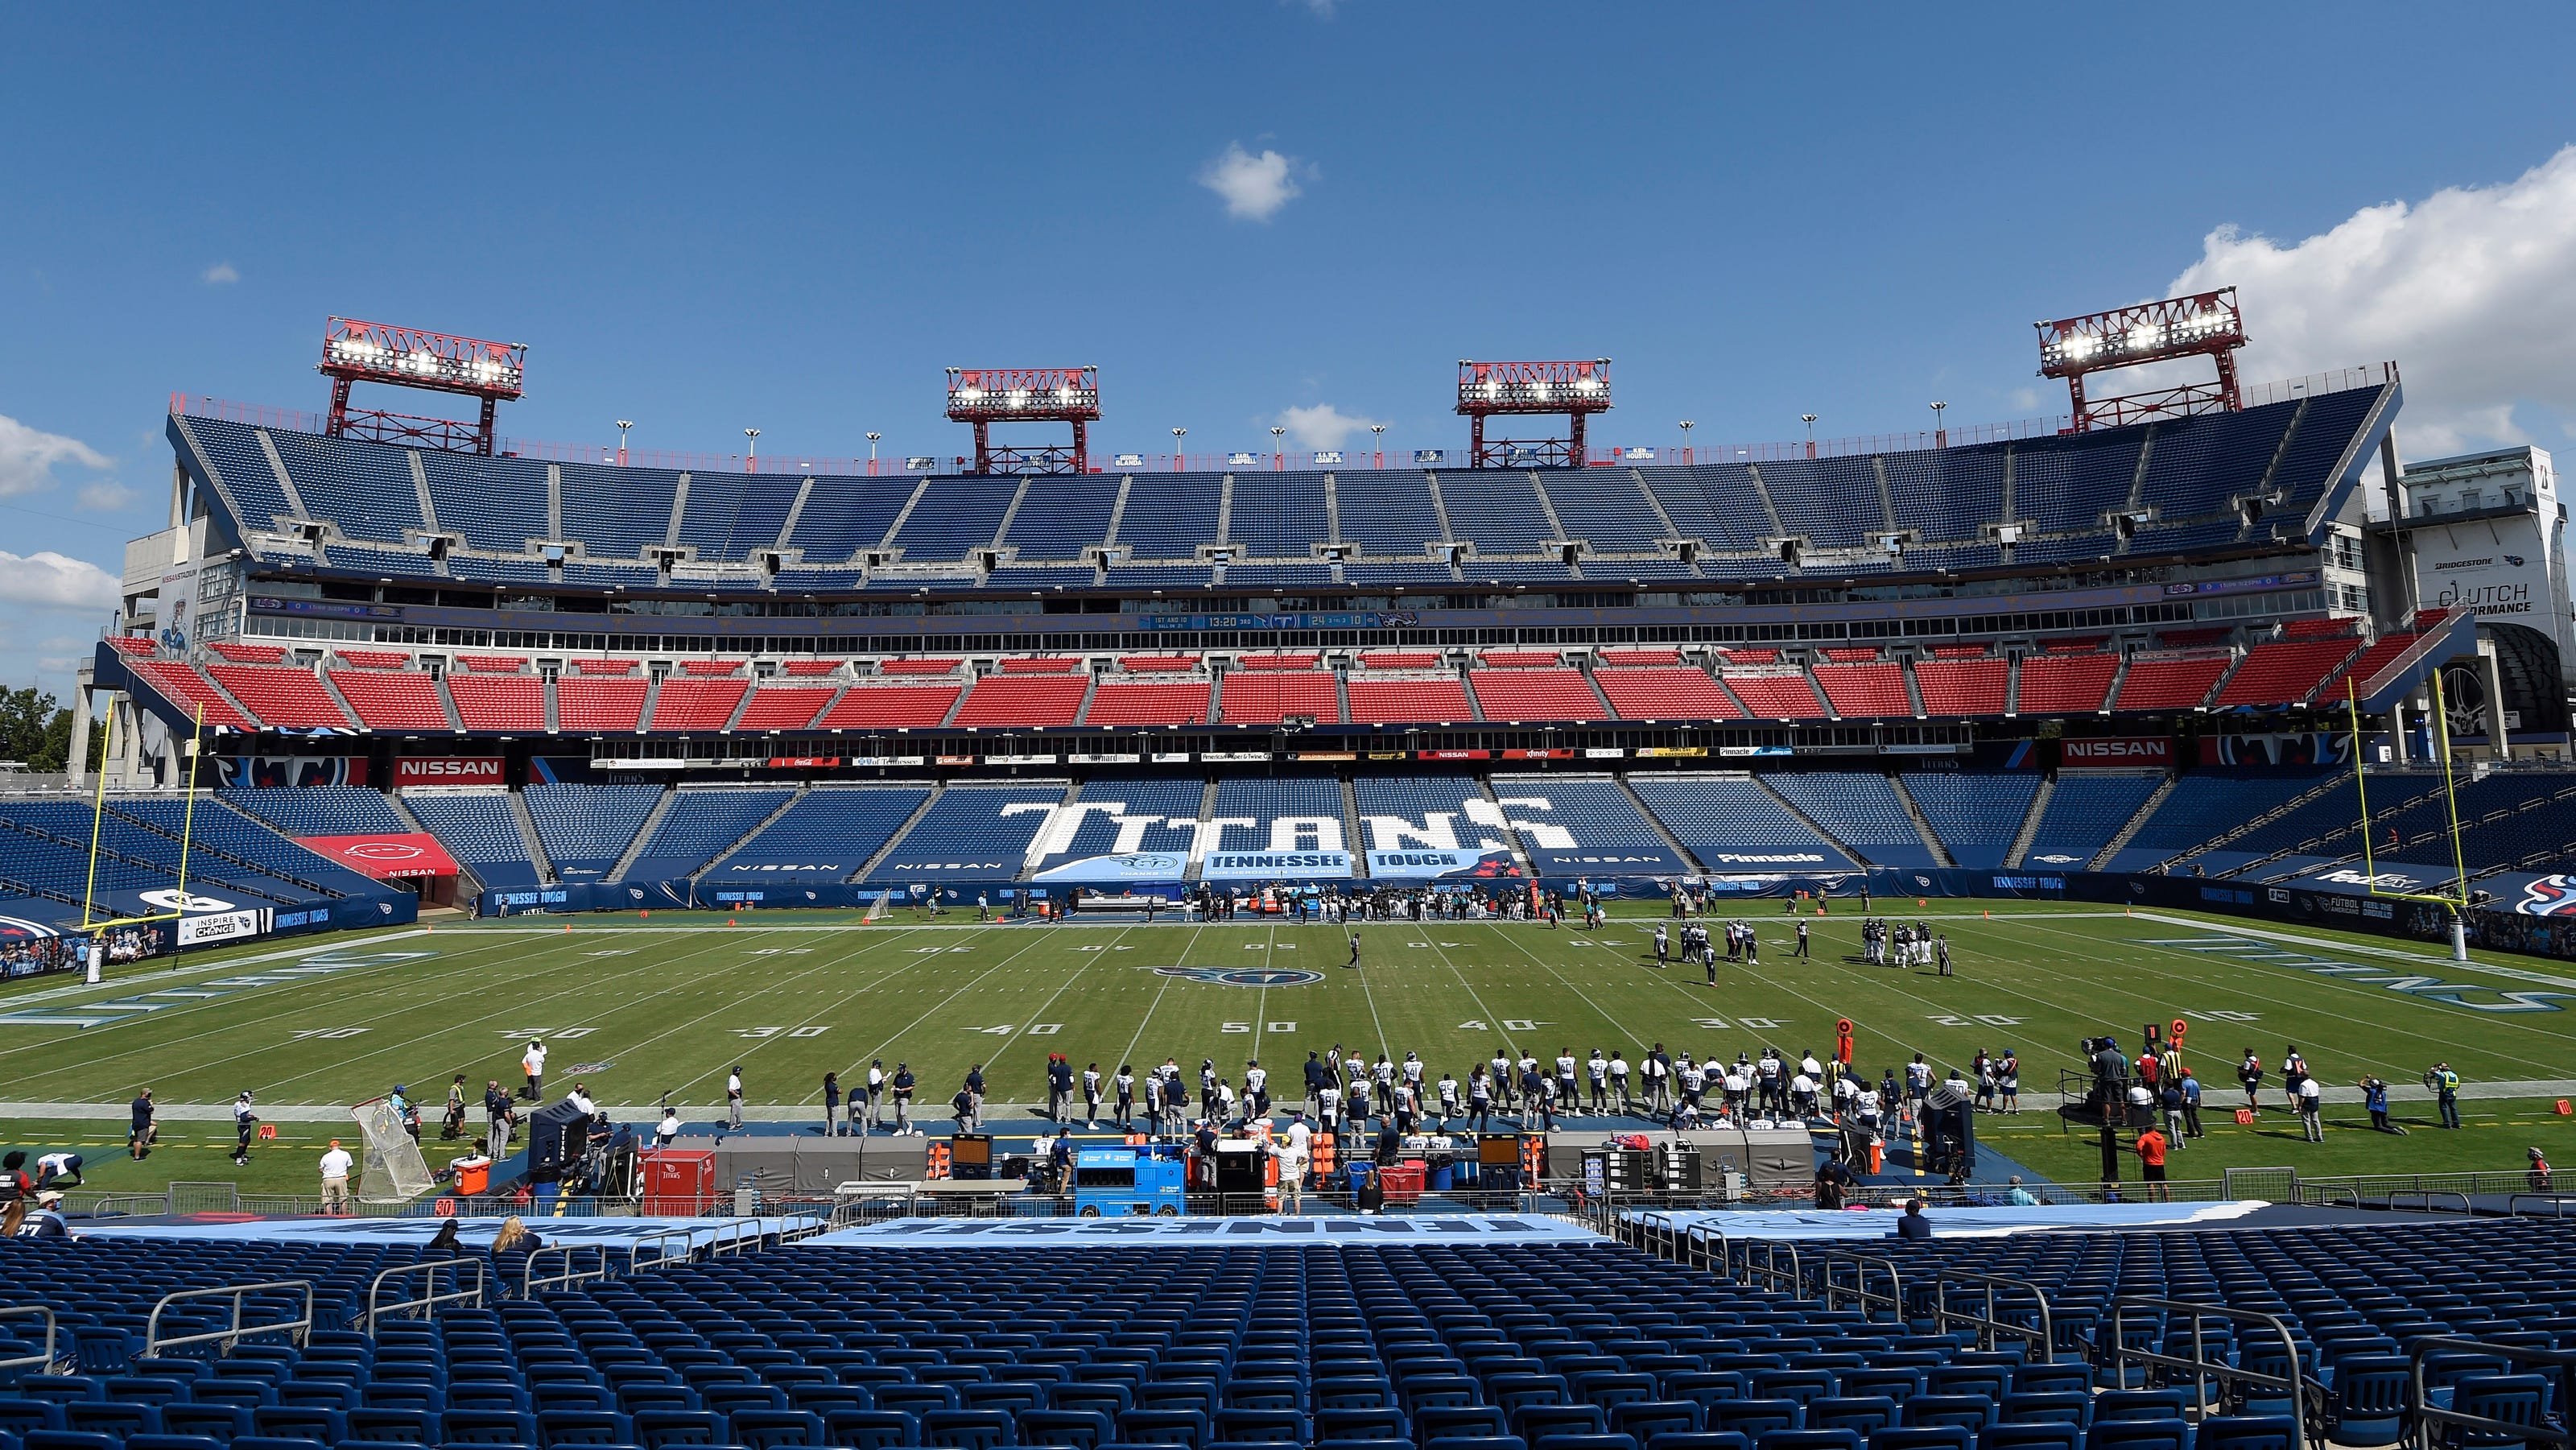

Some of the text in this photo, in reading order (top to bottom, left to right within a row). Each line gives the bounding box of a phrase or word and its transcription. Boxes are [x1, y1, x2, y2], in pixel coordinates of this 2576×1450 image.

[2435, 558, 2492, 570] BRIDGESTONE
[2467, 602, 2531, 616] ORMANCE
[1210, 617, 1236, 626] 13:20
[1312, 616, 1324, 625] 24
[1350, 616, 1360, 625] 10
[1526, 750, 1549, 759] xfinity
[2067, 742, 2165, 757] NISSAN
[402, 761, 498, 775] NISSAN
[1922, 758, 1959, 770] TITANS
[609, 772, 645, 783] TITANS
[1001, 802, 1579, 853] TITANS
[1211, 853, 1458, 868] TENNESSEE TOUGH
[1717, 853, 1824, 864] Pinnacle
[388, 868, 436, 877] NISSAN
[1993, 876, 2037, 889] TENNESSEE
[2314, 869, 2421, 889] FedEx
[1741, 882, 1760, 890] TOUGH
[541, 890, 567, 903] TOUGH
[716, 891, 764, 901] TENNESSEE TOUGH
[2201, 888, 2233, 902] TENNESSEE
[2277, 891, 2288, 900] NFL
[2331, 896, 2359, 908] FÚTBOL
[2363, 900, 2393, 911] FEEL THE
[2330, 907, 2359, 915] AMERICANO
[196, 916, 234, 927] INSPIRE
[275, 908, 329, 928] TENNESSEE TOUGH
[196, 923, 235, 938] CHANGE
[1458, 1020, 1537, 1031] 40
[1690, 1018, 1781, 1029] 30
[1926, 1014, 2020, 1027] 20
[505, 1028, 601, 1039] 20
[740, 1027, 832, 1038] 30
[981, 1023, 1065, 1035] 40
[1221, 1022, 1298, 1033] 50
[1377, 1068, 1389, 1079] 20
[1409, 1068, 1418, 1080] 41
[1560, 1063, 1572, 1074] 40
[1594, 1065, 1603, 1076] 51
[1740, 1068, 1748, 1080] 91
[1763, 1065, 1777, 1076] 92
[1252, 1072, 1260, 1084] 17
[1687, 1076, 1699, 1088] 37
[1325, 1095, 1335, 1108] 81
[1864, 1097, 1876, 1109] 52
[2557, 1100, 2572, 1113] 10
[2238, 1110, 2252, 1122] 20
[259, 1126, 274, 1138] 20
[453, 1171, 464, 1185] G
[663, 1171, 680, 1179] TITANS
[436, 1200, 454, 1215] 30
[17, 1224, 43, 1237] 27
